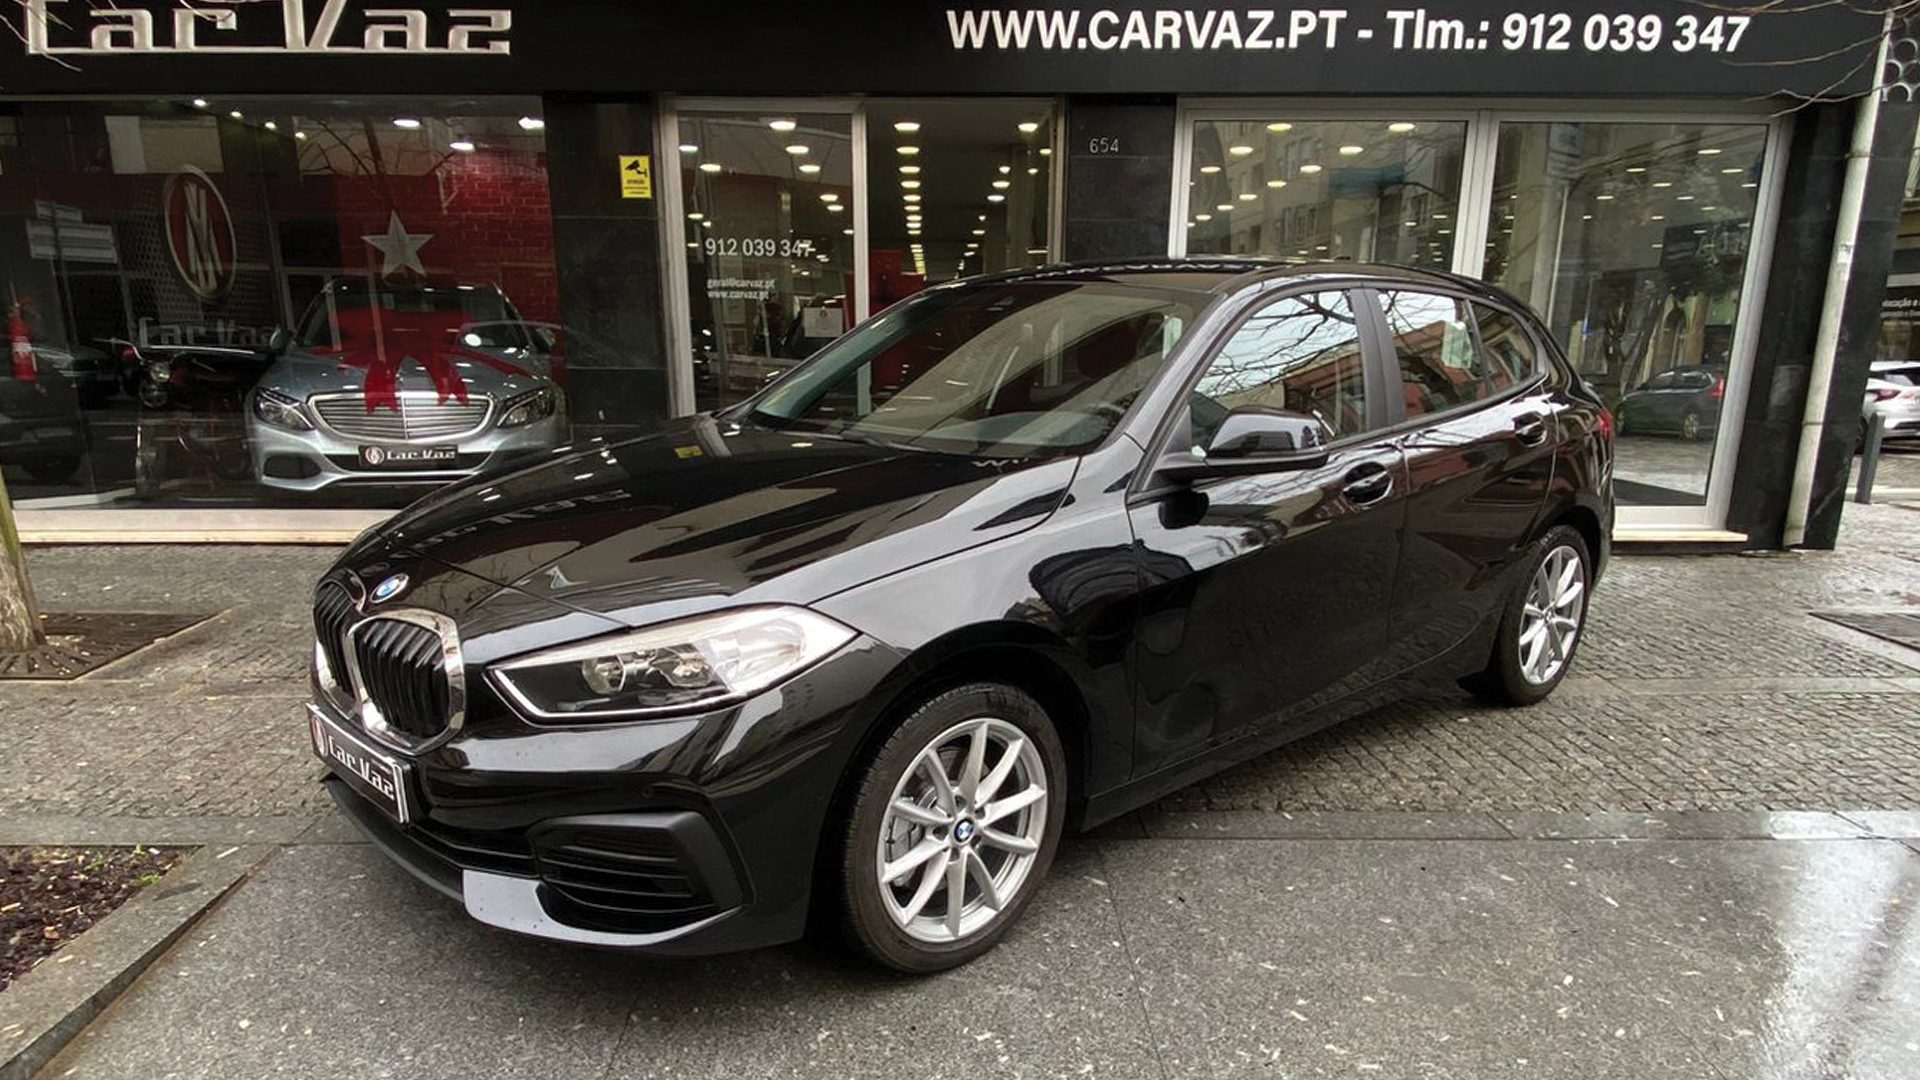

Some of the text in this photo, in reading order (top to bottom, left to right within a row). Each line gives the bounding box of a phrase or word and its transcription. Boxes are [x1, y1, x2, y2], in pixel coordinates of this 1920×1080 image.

[26, 0, 237, 55] Car
[946, 10, 1348, 50] WWW.CARVAZ.PT
[1386, 9, 1490, 50] Tlm.:
[1502, 13, 1572, 51] 912
[1583, 14, 1663, 52] 039
[1673, 15, 1751, 53] 347
[1089, 137, 1119, 154] 654
[705, 238, 812, 257] 912 039 347
[707, 291, 770, 301] www.carvaz.pt
[328, 735, 356, 770] Car
[359, 757, 396, 801] Vaz
